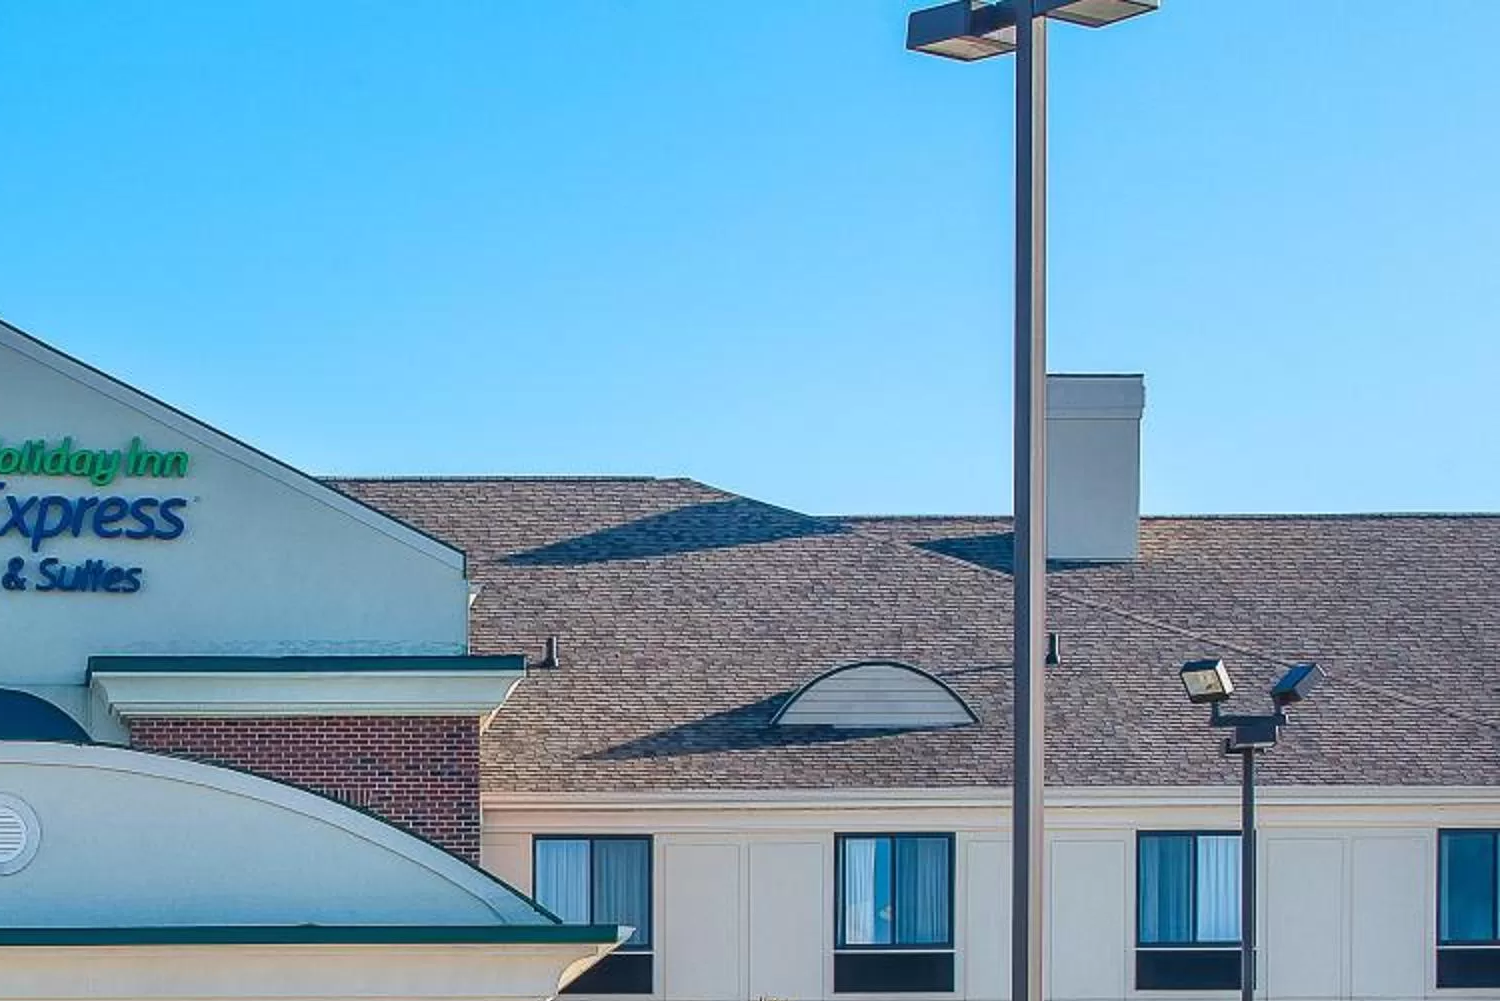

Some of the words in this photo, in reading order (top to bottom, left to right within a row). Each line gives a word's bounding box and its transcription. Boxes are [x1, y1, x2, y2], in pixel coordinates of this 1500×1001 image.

[127, 436, 190, 479] Inn
[1, 557, 27, 592] &
[35, 557, 143, 594] Suites
